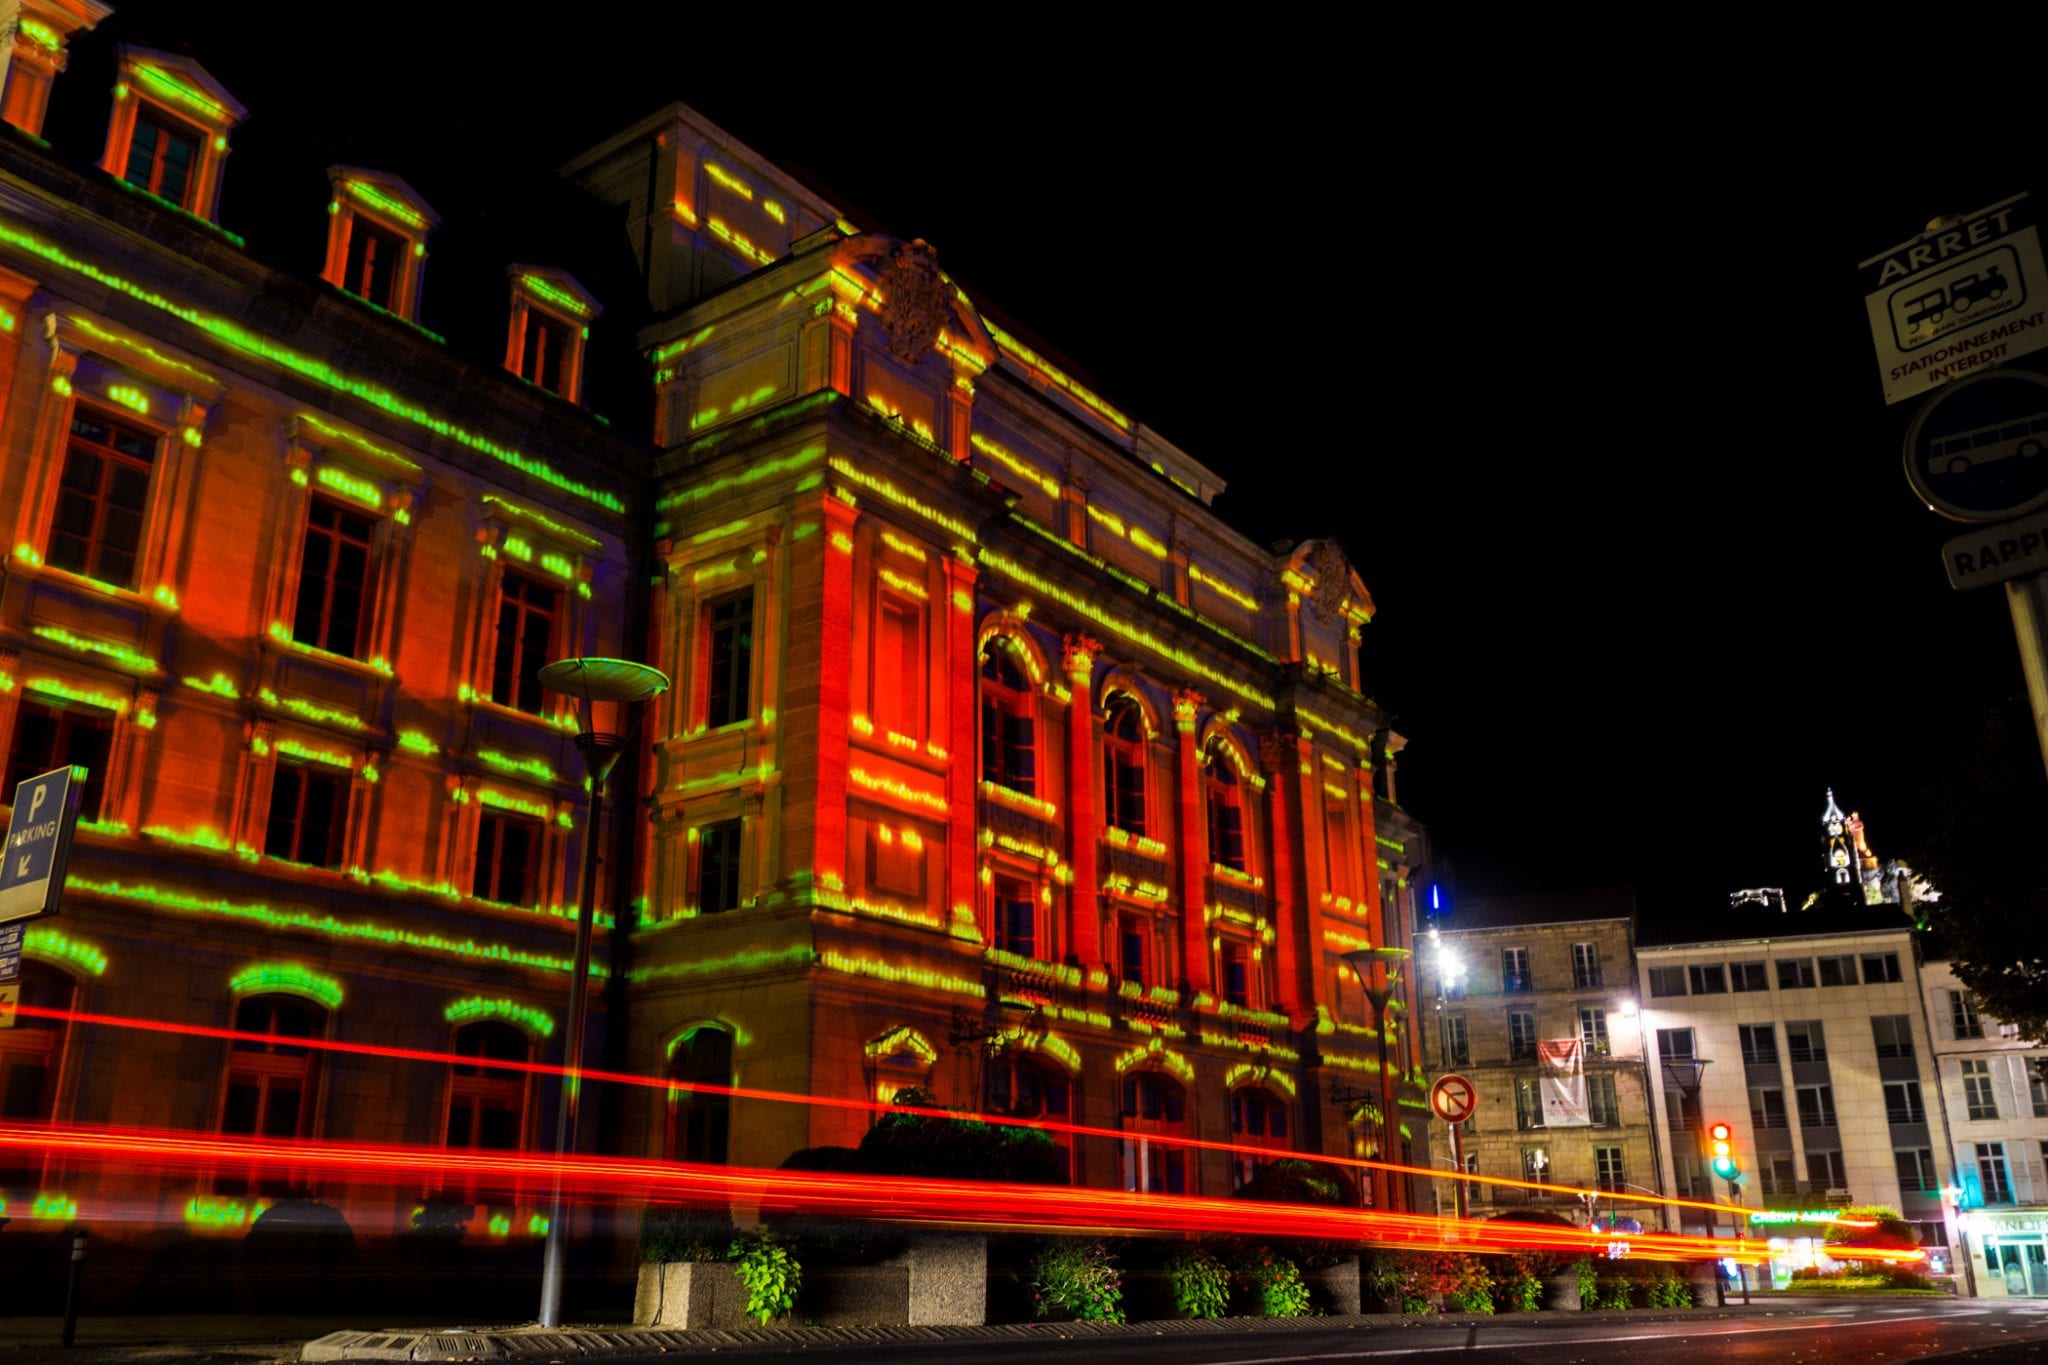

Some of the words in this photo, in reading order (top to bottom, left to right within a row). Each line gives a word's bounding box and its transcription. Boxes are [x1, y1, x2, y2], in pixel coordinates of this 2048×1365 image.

[1877, 207, 2012, 287] ARRET
[1890, 312, 2045, 381] STATIONNEMENT
[1928, 343, 2009, 382] INTERDIT
[27, 784, 48, 823] P
[9, 820, 56, 848] PARKING
